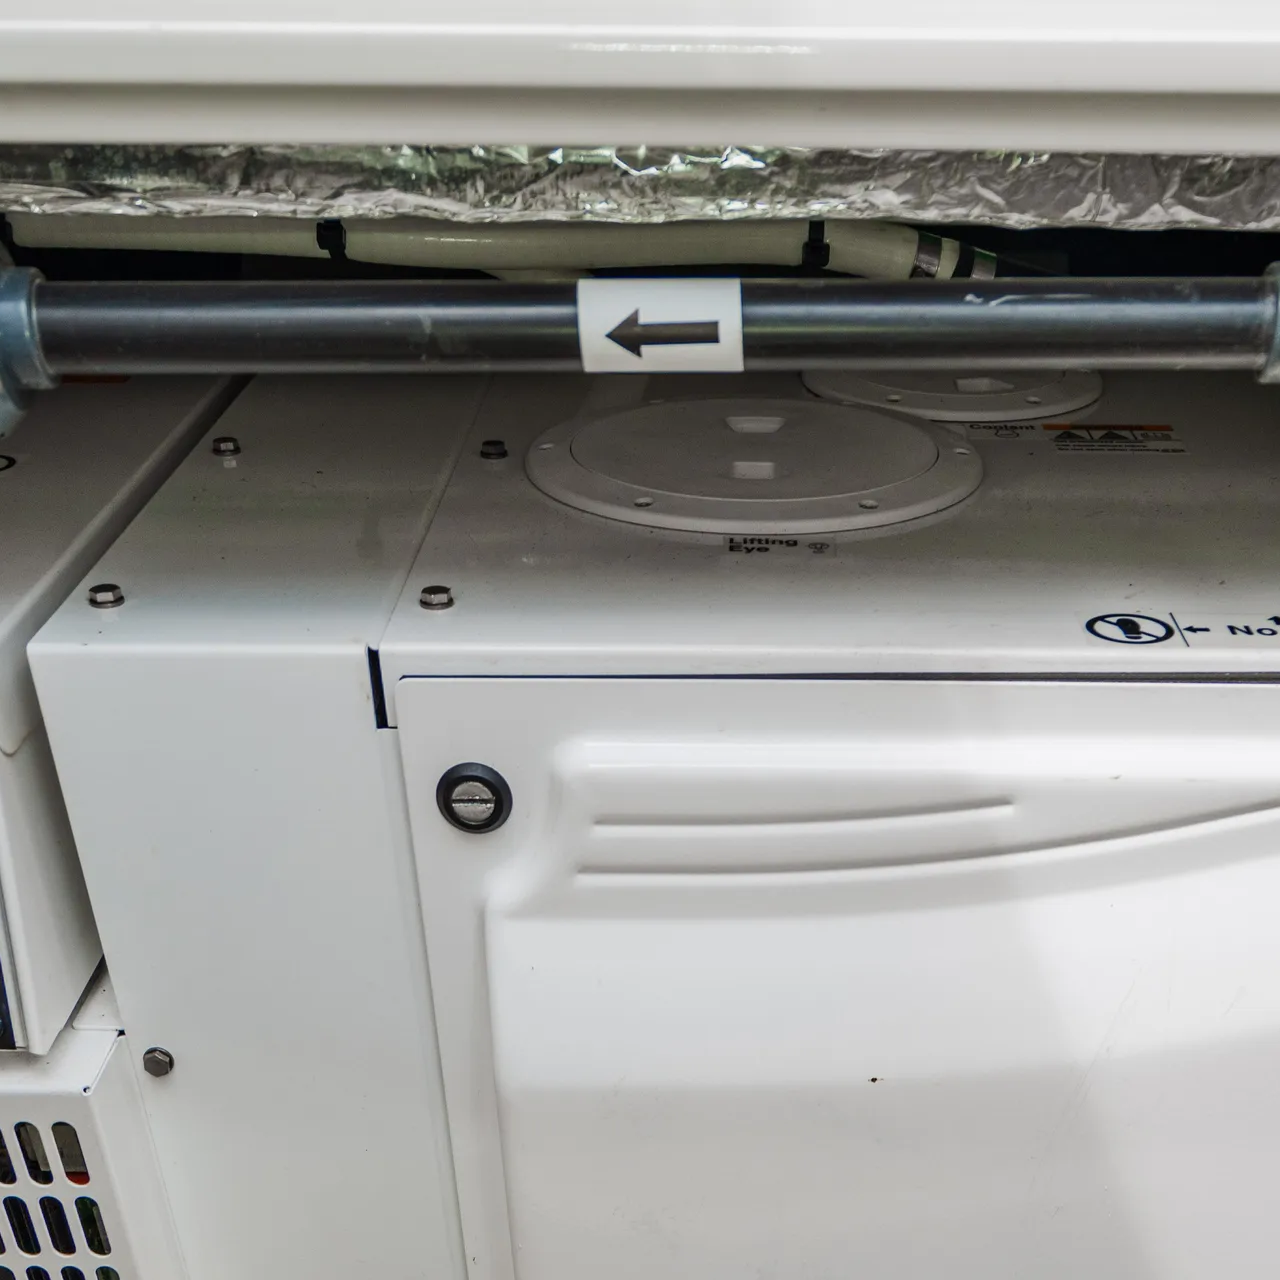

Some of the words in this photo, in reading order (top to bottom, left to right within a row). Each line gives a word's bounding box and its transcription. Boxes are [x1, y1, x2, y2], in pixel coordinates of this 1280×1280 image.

[728, 538, 798, 547] Lifting
[728, 545, 770, 554] Eye
[1227, 625, 1278, 636] No
